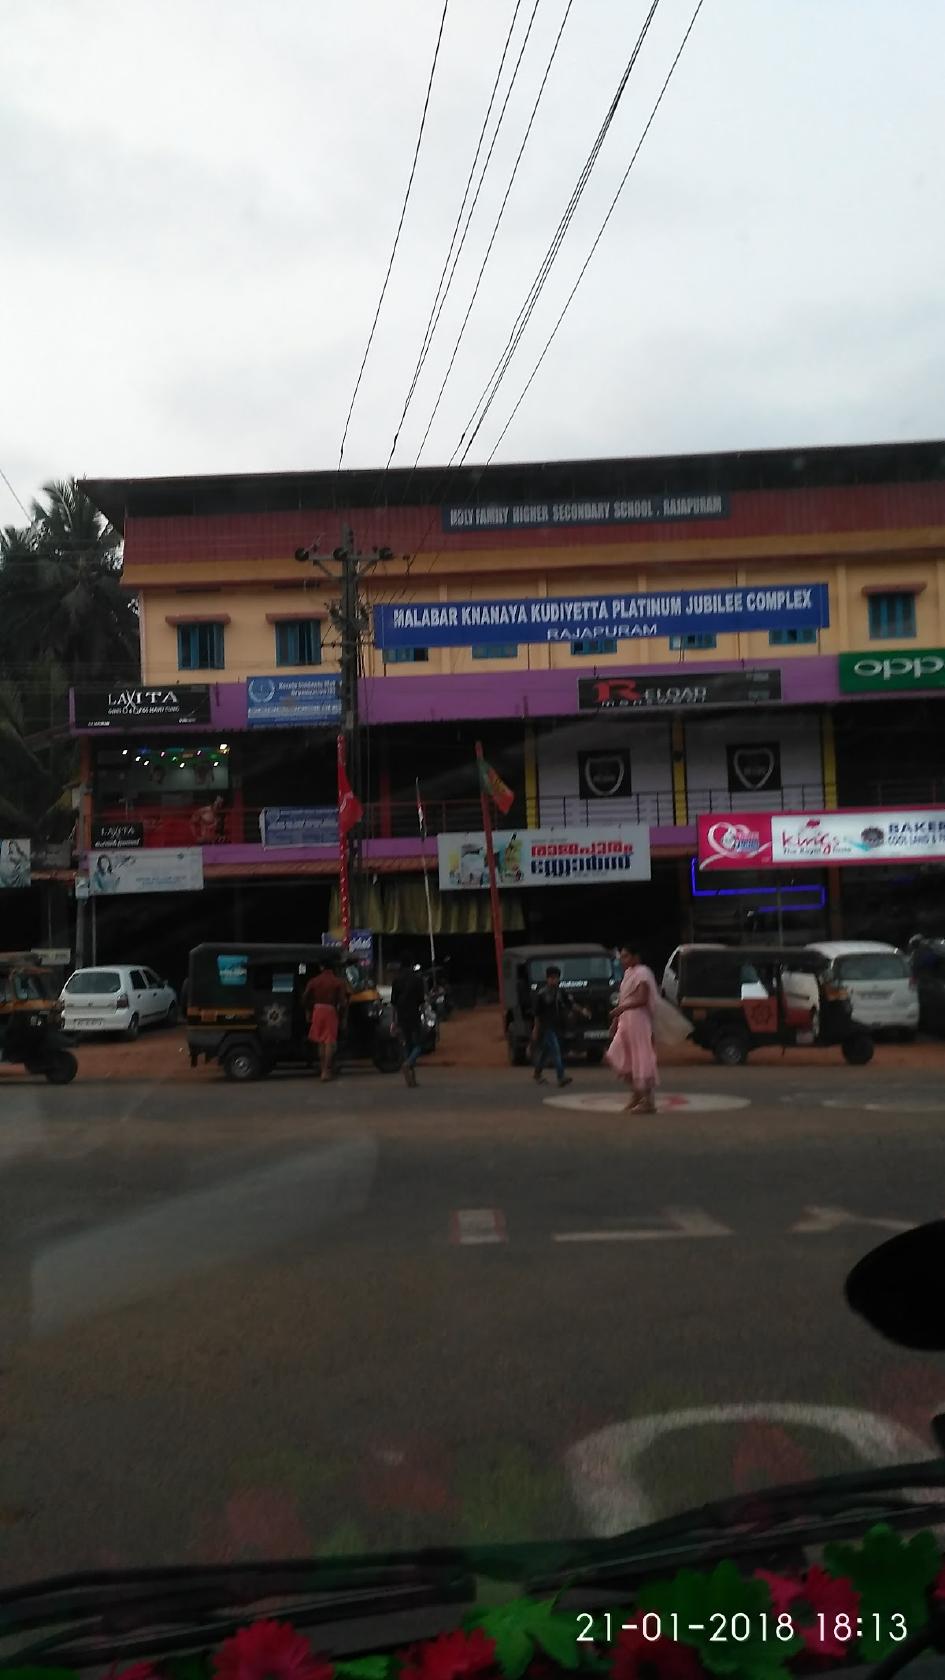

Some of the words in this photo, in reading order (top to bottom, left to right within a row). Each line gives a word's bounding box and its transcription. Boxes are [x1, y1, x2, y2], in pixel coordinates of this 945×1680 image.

[475, 507, 509, 526] FAMILY
[512, 505, 548, 524] HIGHER
[552, 501, 610, 522] SECONDARY
[663, 495, 722, 516] RAJAPURAM
[393, 607, 458, 629] MALABAR
[462, 603, 528, 626] KNANAYA
[531, 600, 609, 623] KUDIYETTA
[612, 596, 682, 619] PLATINUM
[685, 592, 743, 615] JUBILEE
[747, 589, 812, 611] COMPLEX
[546, 624, 657, 641] RAJAPURAM
